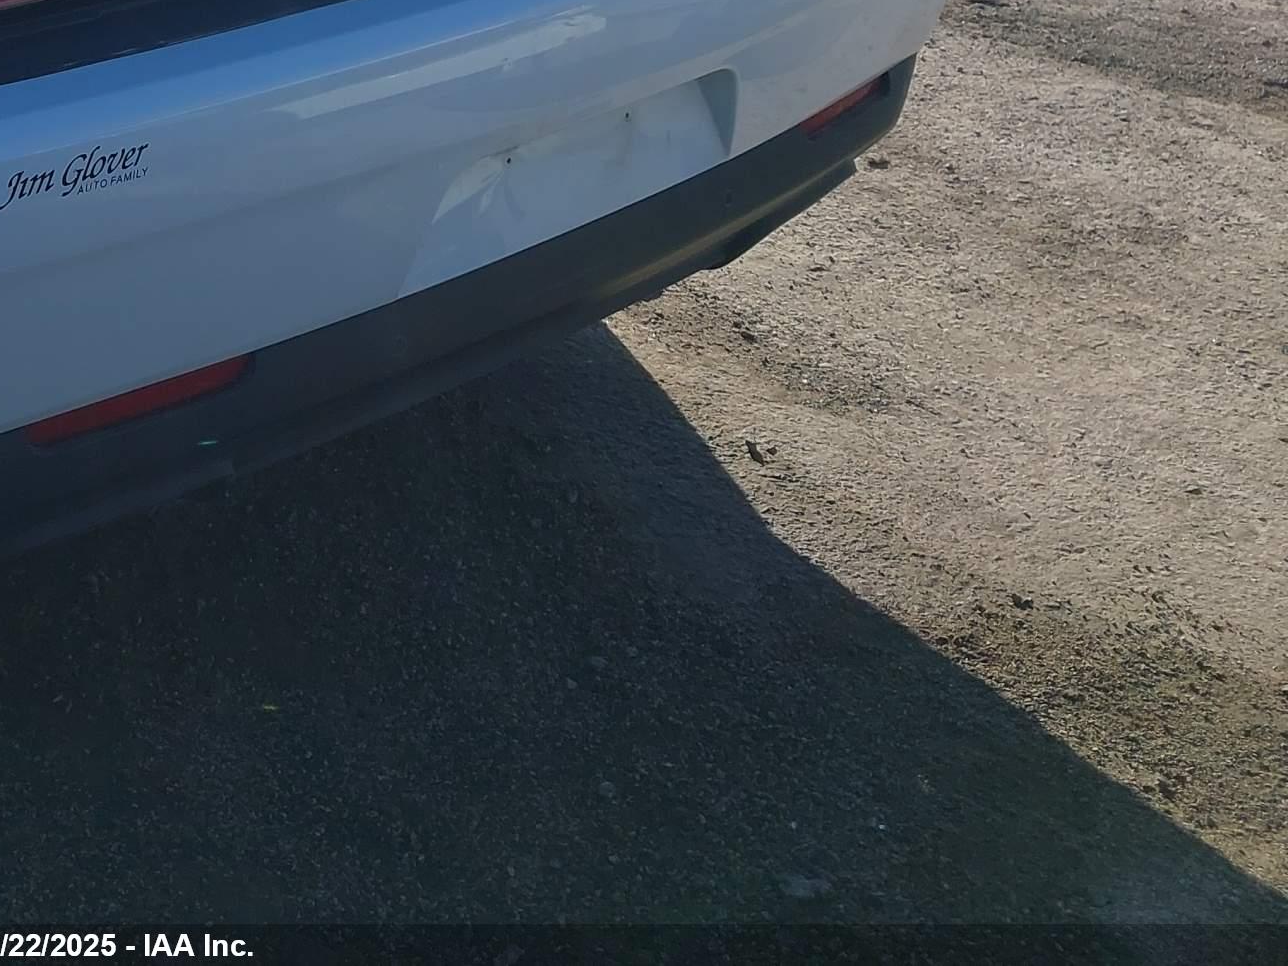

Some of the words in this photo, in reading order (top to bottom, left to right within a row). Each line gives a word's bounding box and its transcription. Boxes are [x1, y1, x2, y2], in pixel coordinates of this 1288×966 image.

[61, 144, 150, 197] Glover
[76, 177, 108, 196] AUTO
[109, 166, 150, 186] FAMILY
